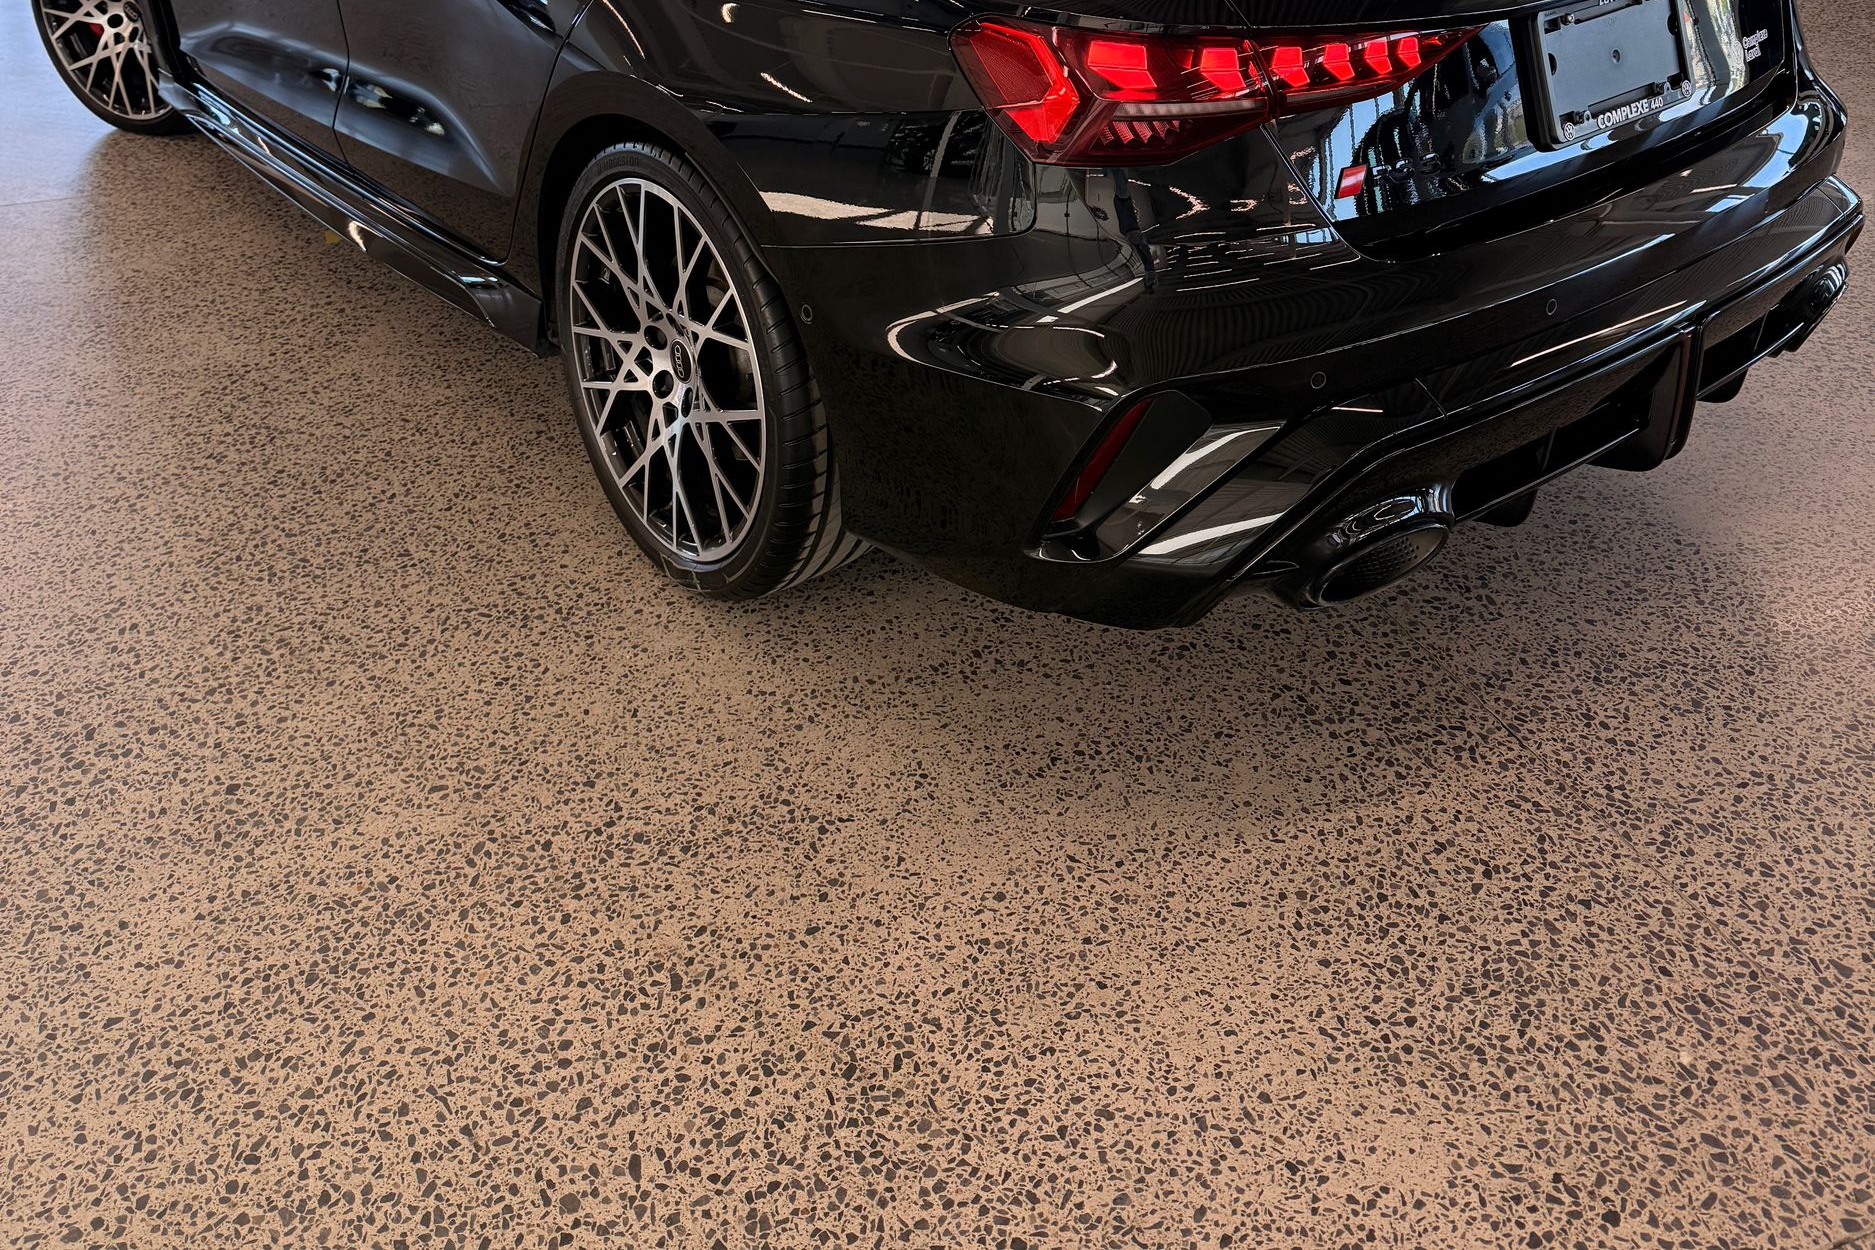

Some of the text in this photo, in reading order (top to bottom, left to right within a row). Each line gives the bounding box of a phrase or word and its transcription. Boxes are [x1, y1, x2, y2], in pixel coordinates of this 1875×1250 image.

[1743, 28, 1768, 49] Complexe
[1597, 97, 1664, 129] COMPLEXE 440
